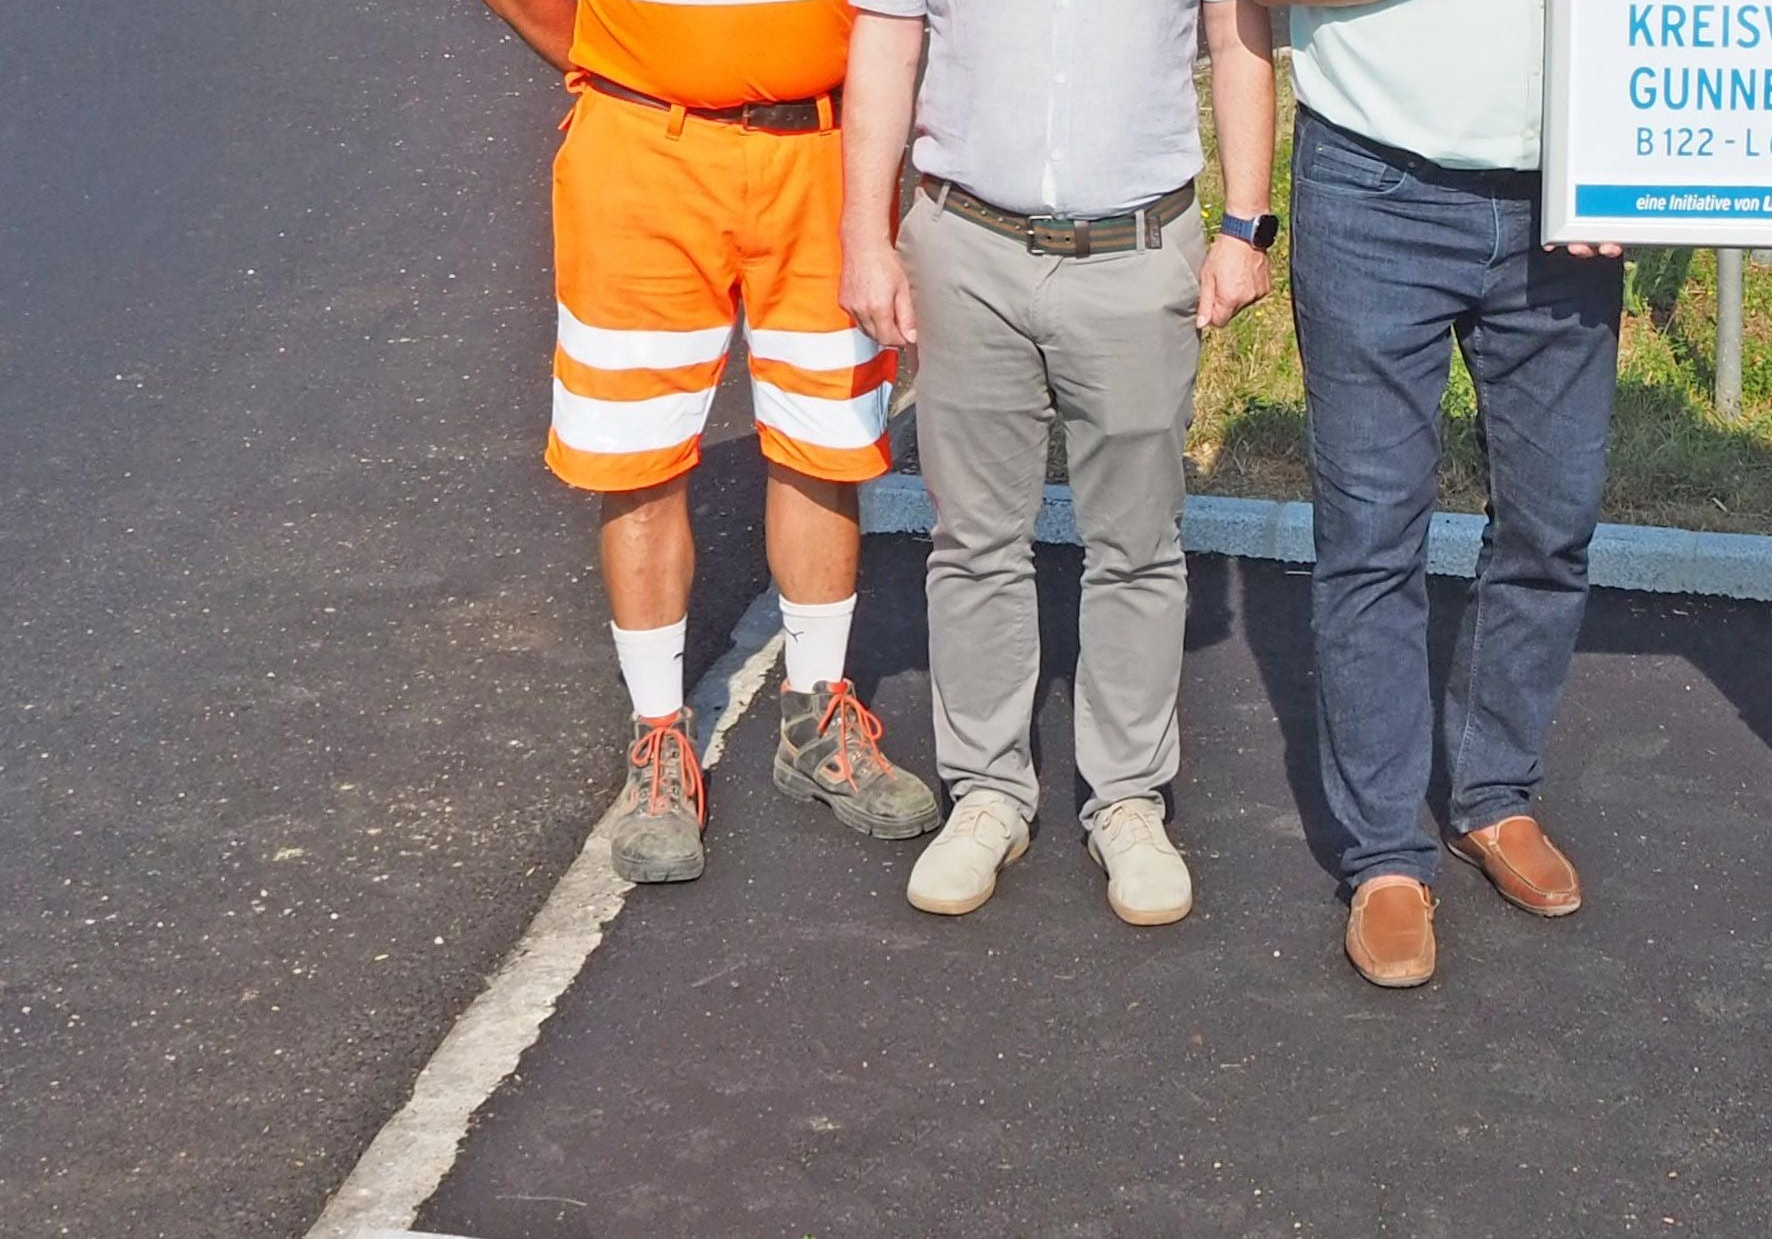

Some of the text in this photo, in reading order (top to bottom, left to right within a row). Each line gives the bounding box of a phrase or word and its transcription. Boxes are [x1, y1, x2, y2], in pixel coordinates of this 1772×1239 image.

[1636, 126, 1654, 156] B
[1663, 127, 1714, 157] 122
[1636, 195, 1666, 211] eine
[1669, 195, 1731, 211] Initiative
[1734, 198, 1760, 211] von
